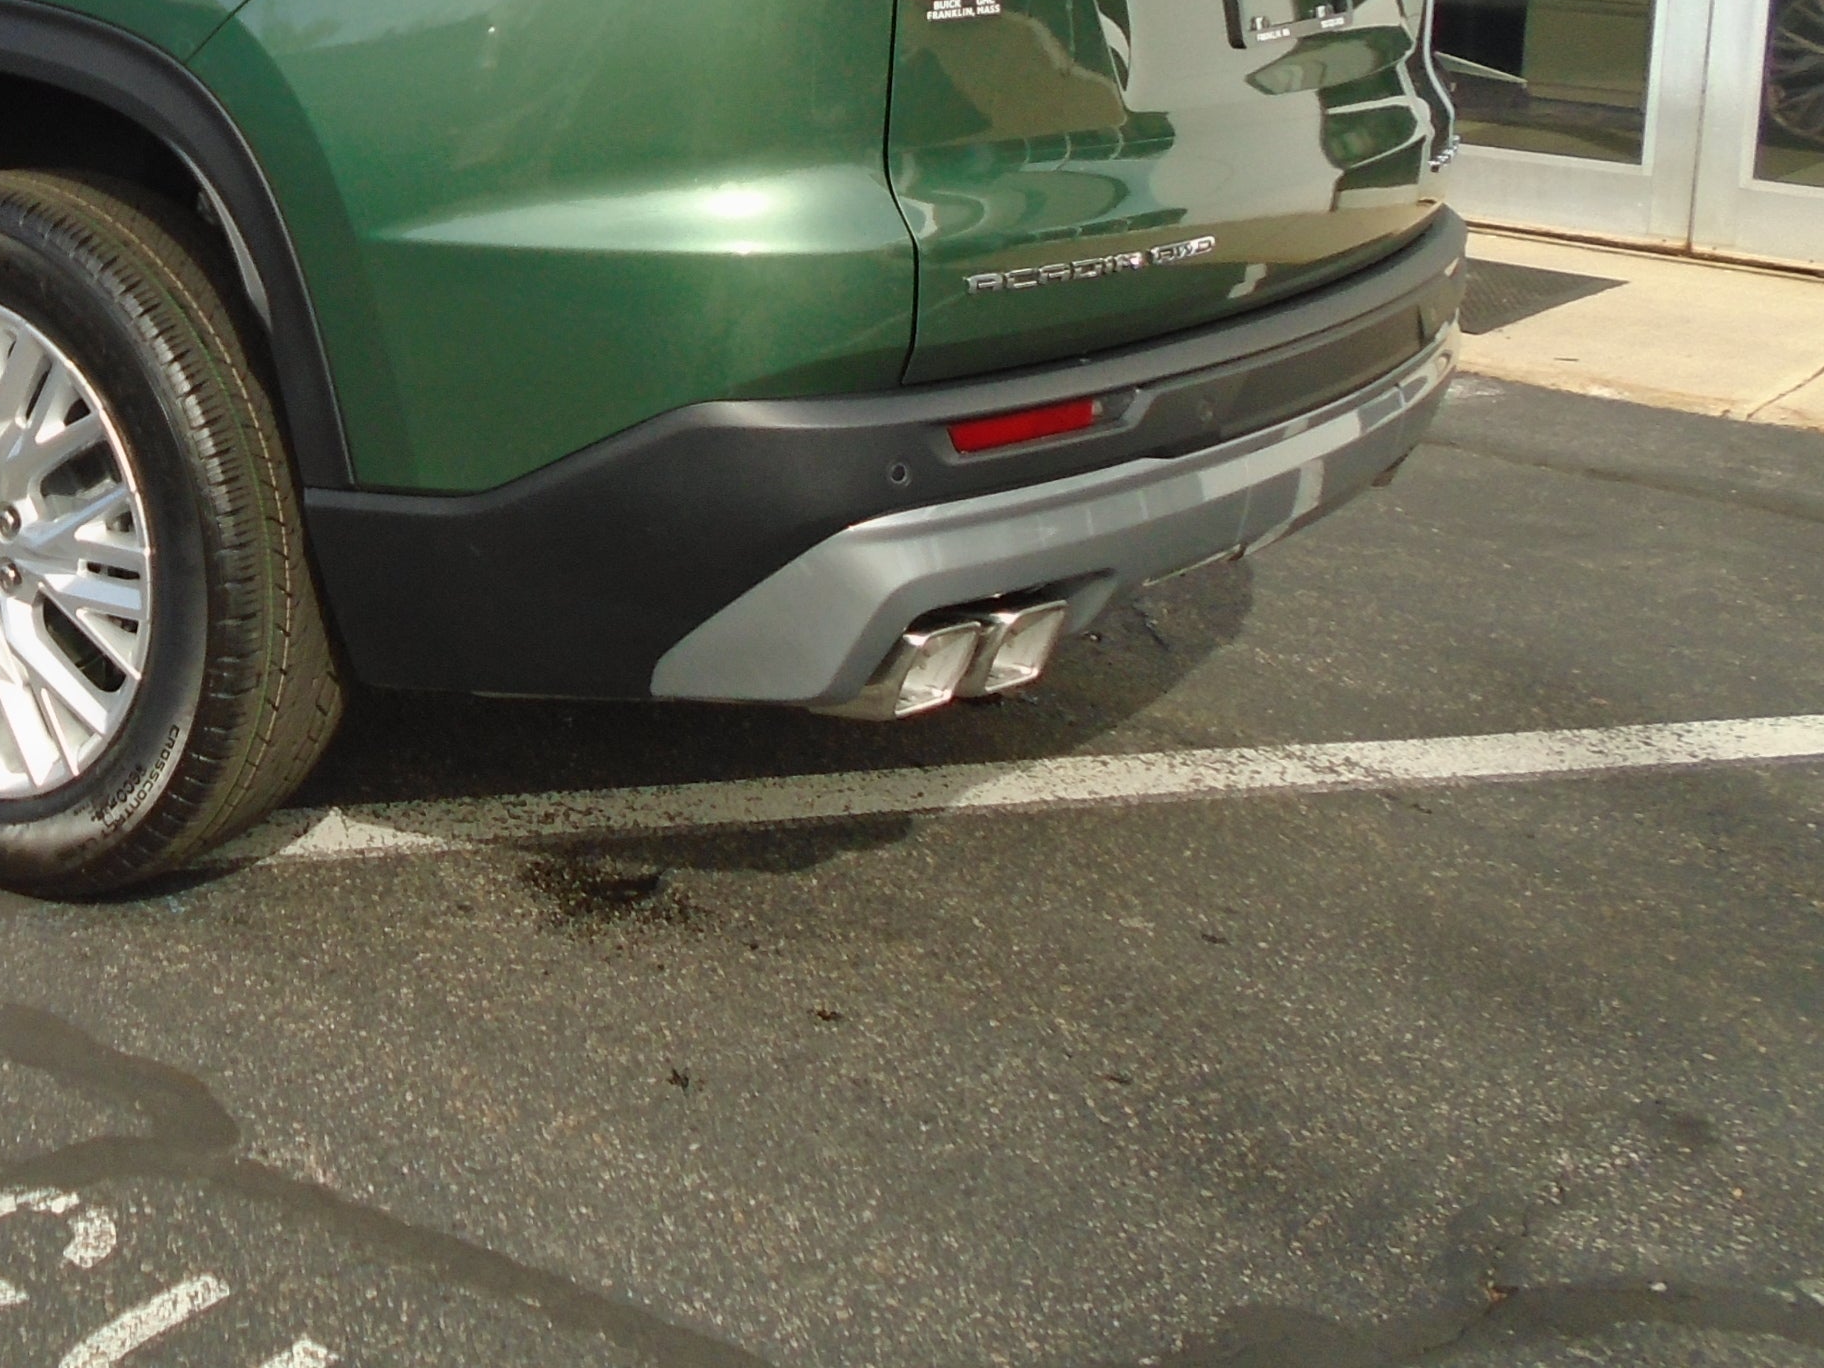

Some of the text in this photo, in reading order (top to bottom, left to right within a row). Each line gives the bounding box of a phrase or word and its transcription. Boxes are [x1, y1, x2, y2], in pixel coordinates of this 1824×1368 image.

[926, 4, 1001, 21] FRANKLIN, MASS
[933, 0, 962, 11] BUICK
[963, 251, 1144, 296] ACADIA
